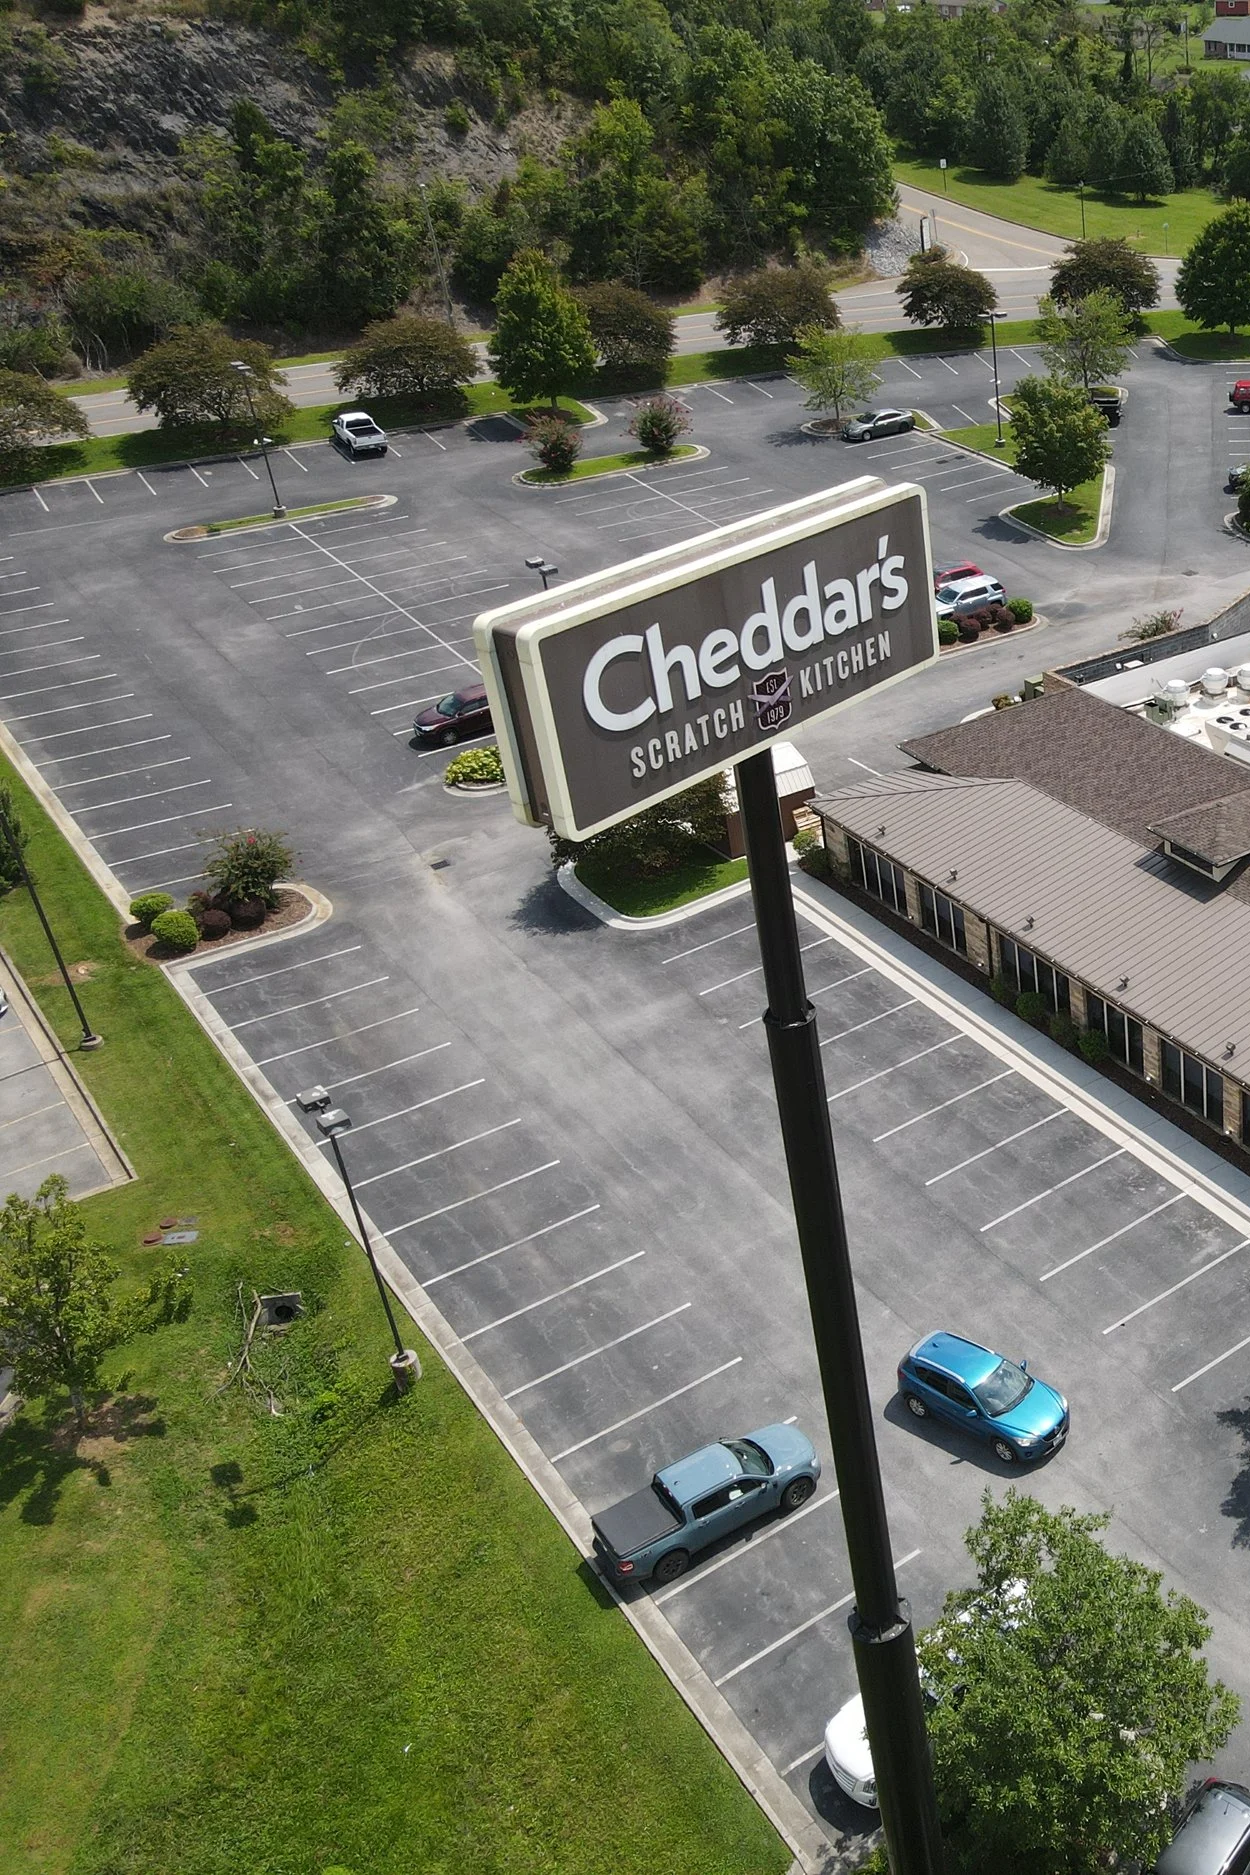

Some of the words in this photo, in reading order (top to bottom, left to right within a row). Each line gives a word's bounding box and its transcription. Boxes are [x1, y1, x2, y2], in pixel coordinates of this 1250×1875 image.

[583, 535, 909, 731] Cheddar's
[630, 699, 745, 778] SCRATCH
[800, 631, 892, 698] KITCHEN
[767, 705, 785, 724] 1979
